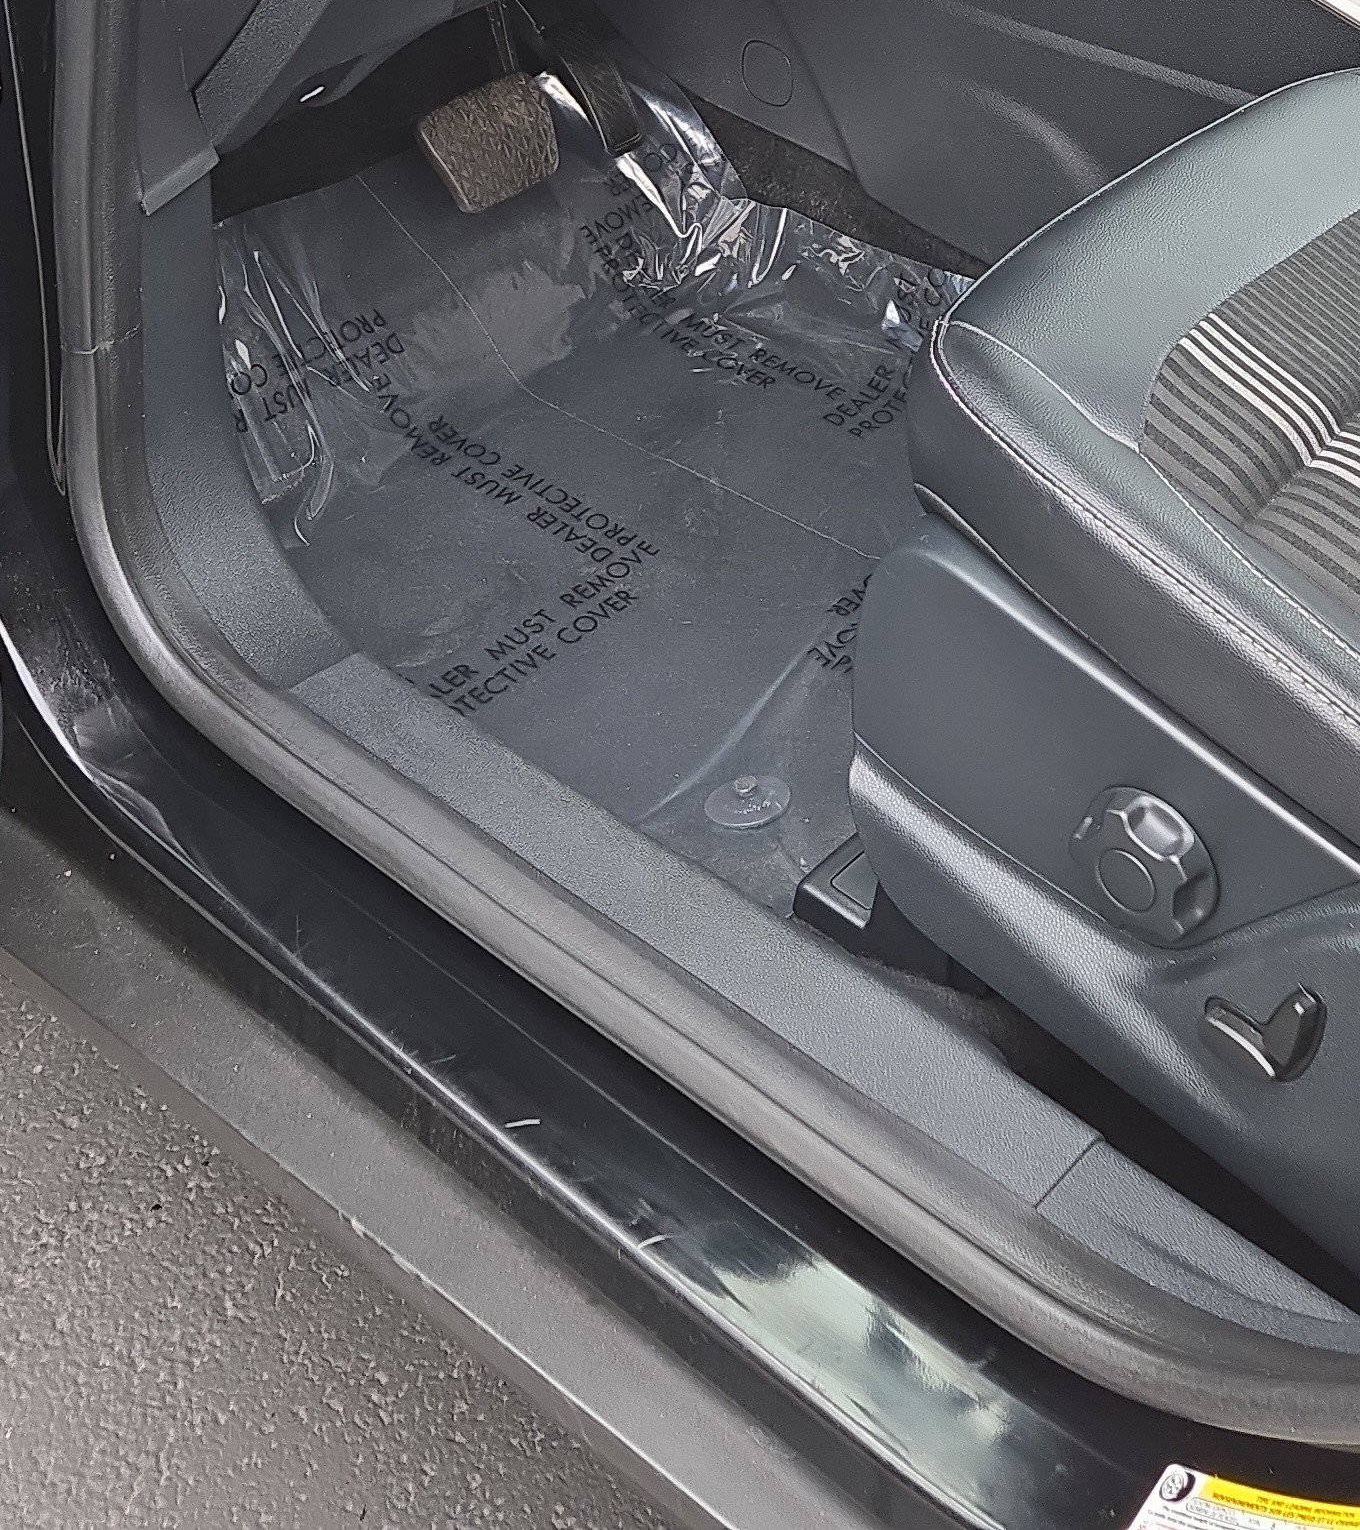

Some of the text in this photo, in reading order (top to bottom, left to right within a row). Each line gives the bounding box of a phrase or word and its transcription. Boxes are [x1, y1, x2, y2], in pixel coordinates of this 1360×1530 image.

[748, 348, 846, 400] REMOVE
[823, 364, 891, 426] DEALER
[375, 372, 614, 563] DEALER MUST REMOVE
[428, 415, 643, 547] PROTECTIVE COVER
[484, 609, 556, 660] MUST
[559, 540, 660, 608] REMOVE
[557, 590, 638, 644] COVER
